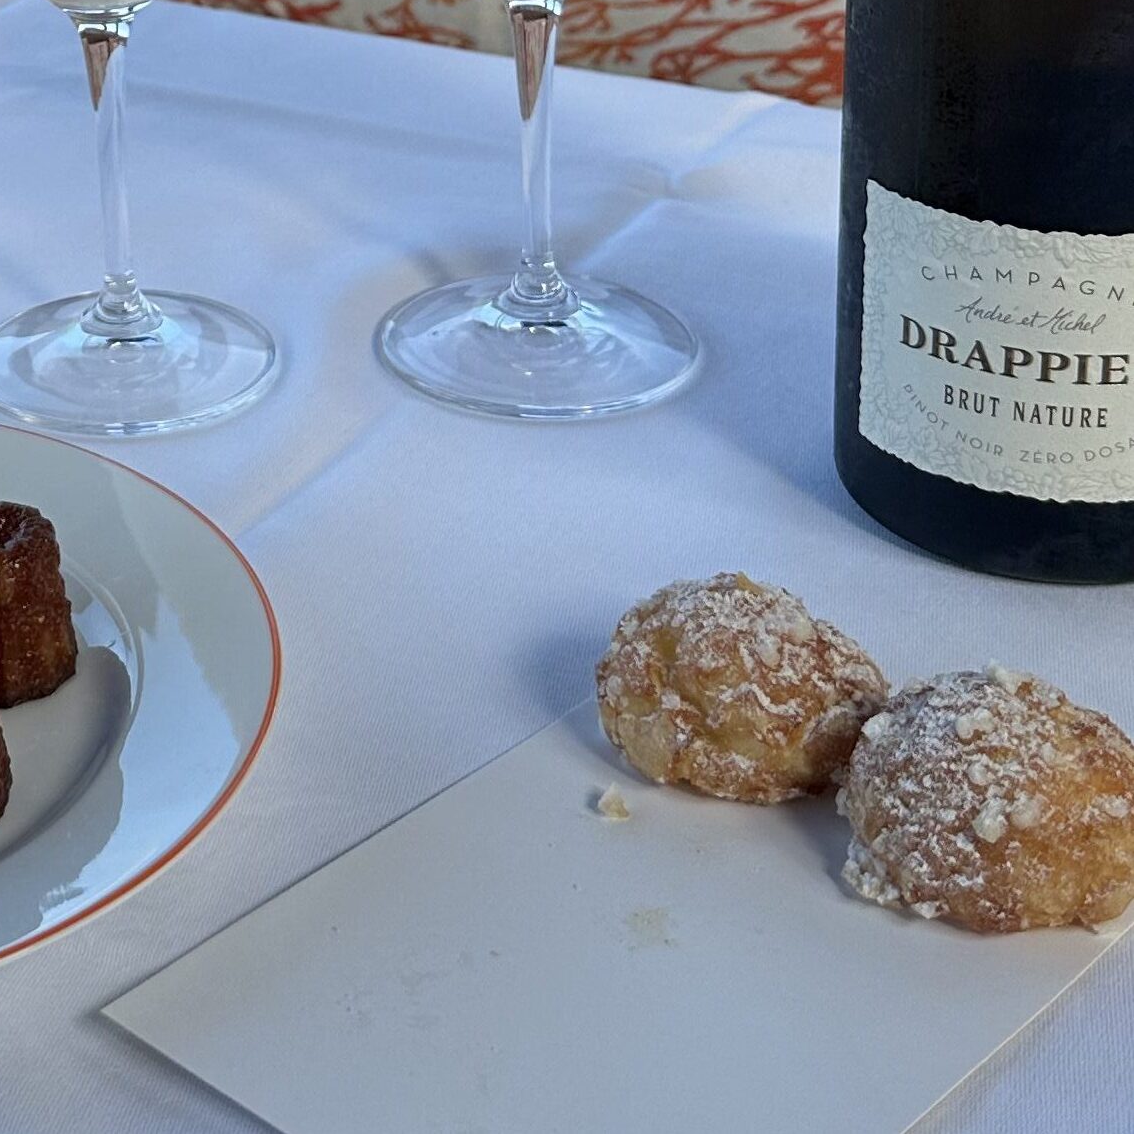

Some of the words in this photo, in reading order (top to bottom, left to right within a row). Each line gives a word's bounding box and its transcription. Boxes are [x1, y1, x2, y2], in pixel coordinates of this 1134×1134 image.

[921, 265, 1134, 306] CHAMPAGN
[954, 296, 1015, 324] André
[1037, 307, 1107, 335] Michel
[899, 314, 1130, 386] DRAPPIE
[903, 383, 949, 431] PINOT
[955, 430, 1004, 457] NOIR
[944, 384, 1000, 418] BRUT
[1013, 400, 1108, 429] NATURE
